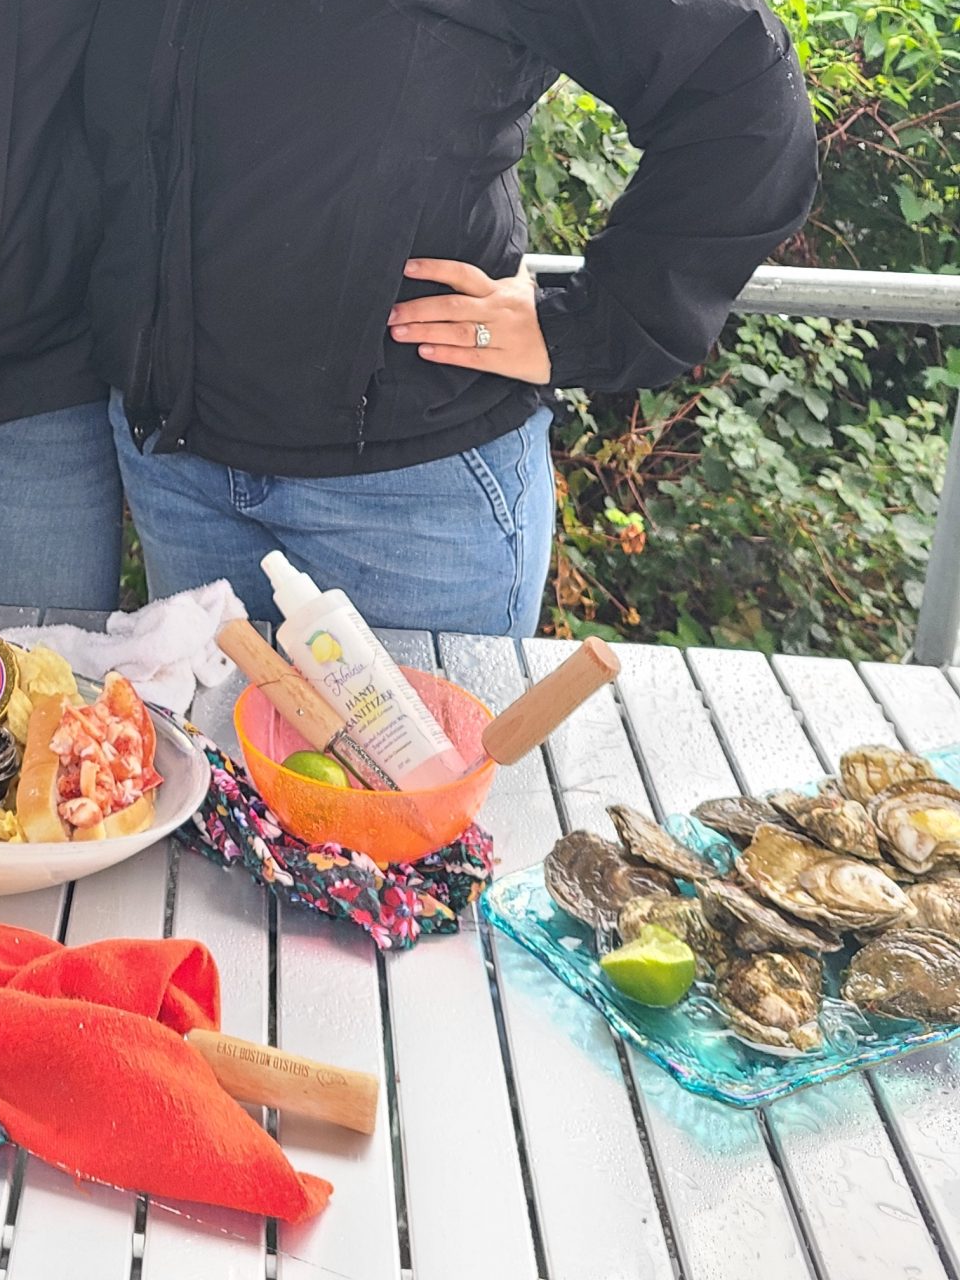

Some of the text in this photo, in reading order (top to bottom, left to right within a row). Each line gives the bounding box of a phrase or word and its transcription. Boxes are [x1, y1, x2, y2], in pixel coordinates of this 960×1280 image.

[345, 684, 376, 711] HAND
[345, 689, 395, 731] SANITIZER
[216, 1041, 310, 1077] EAST BOSTON OYSTERS
